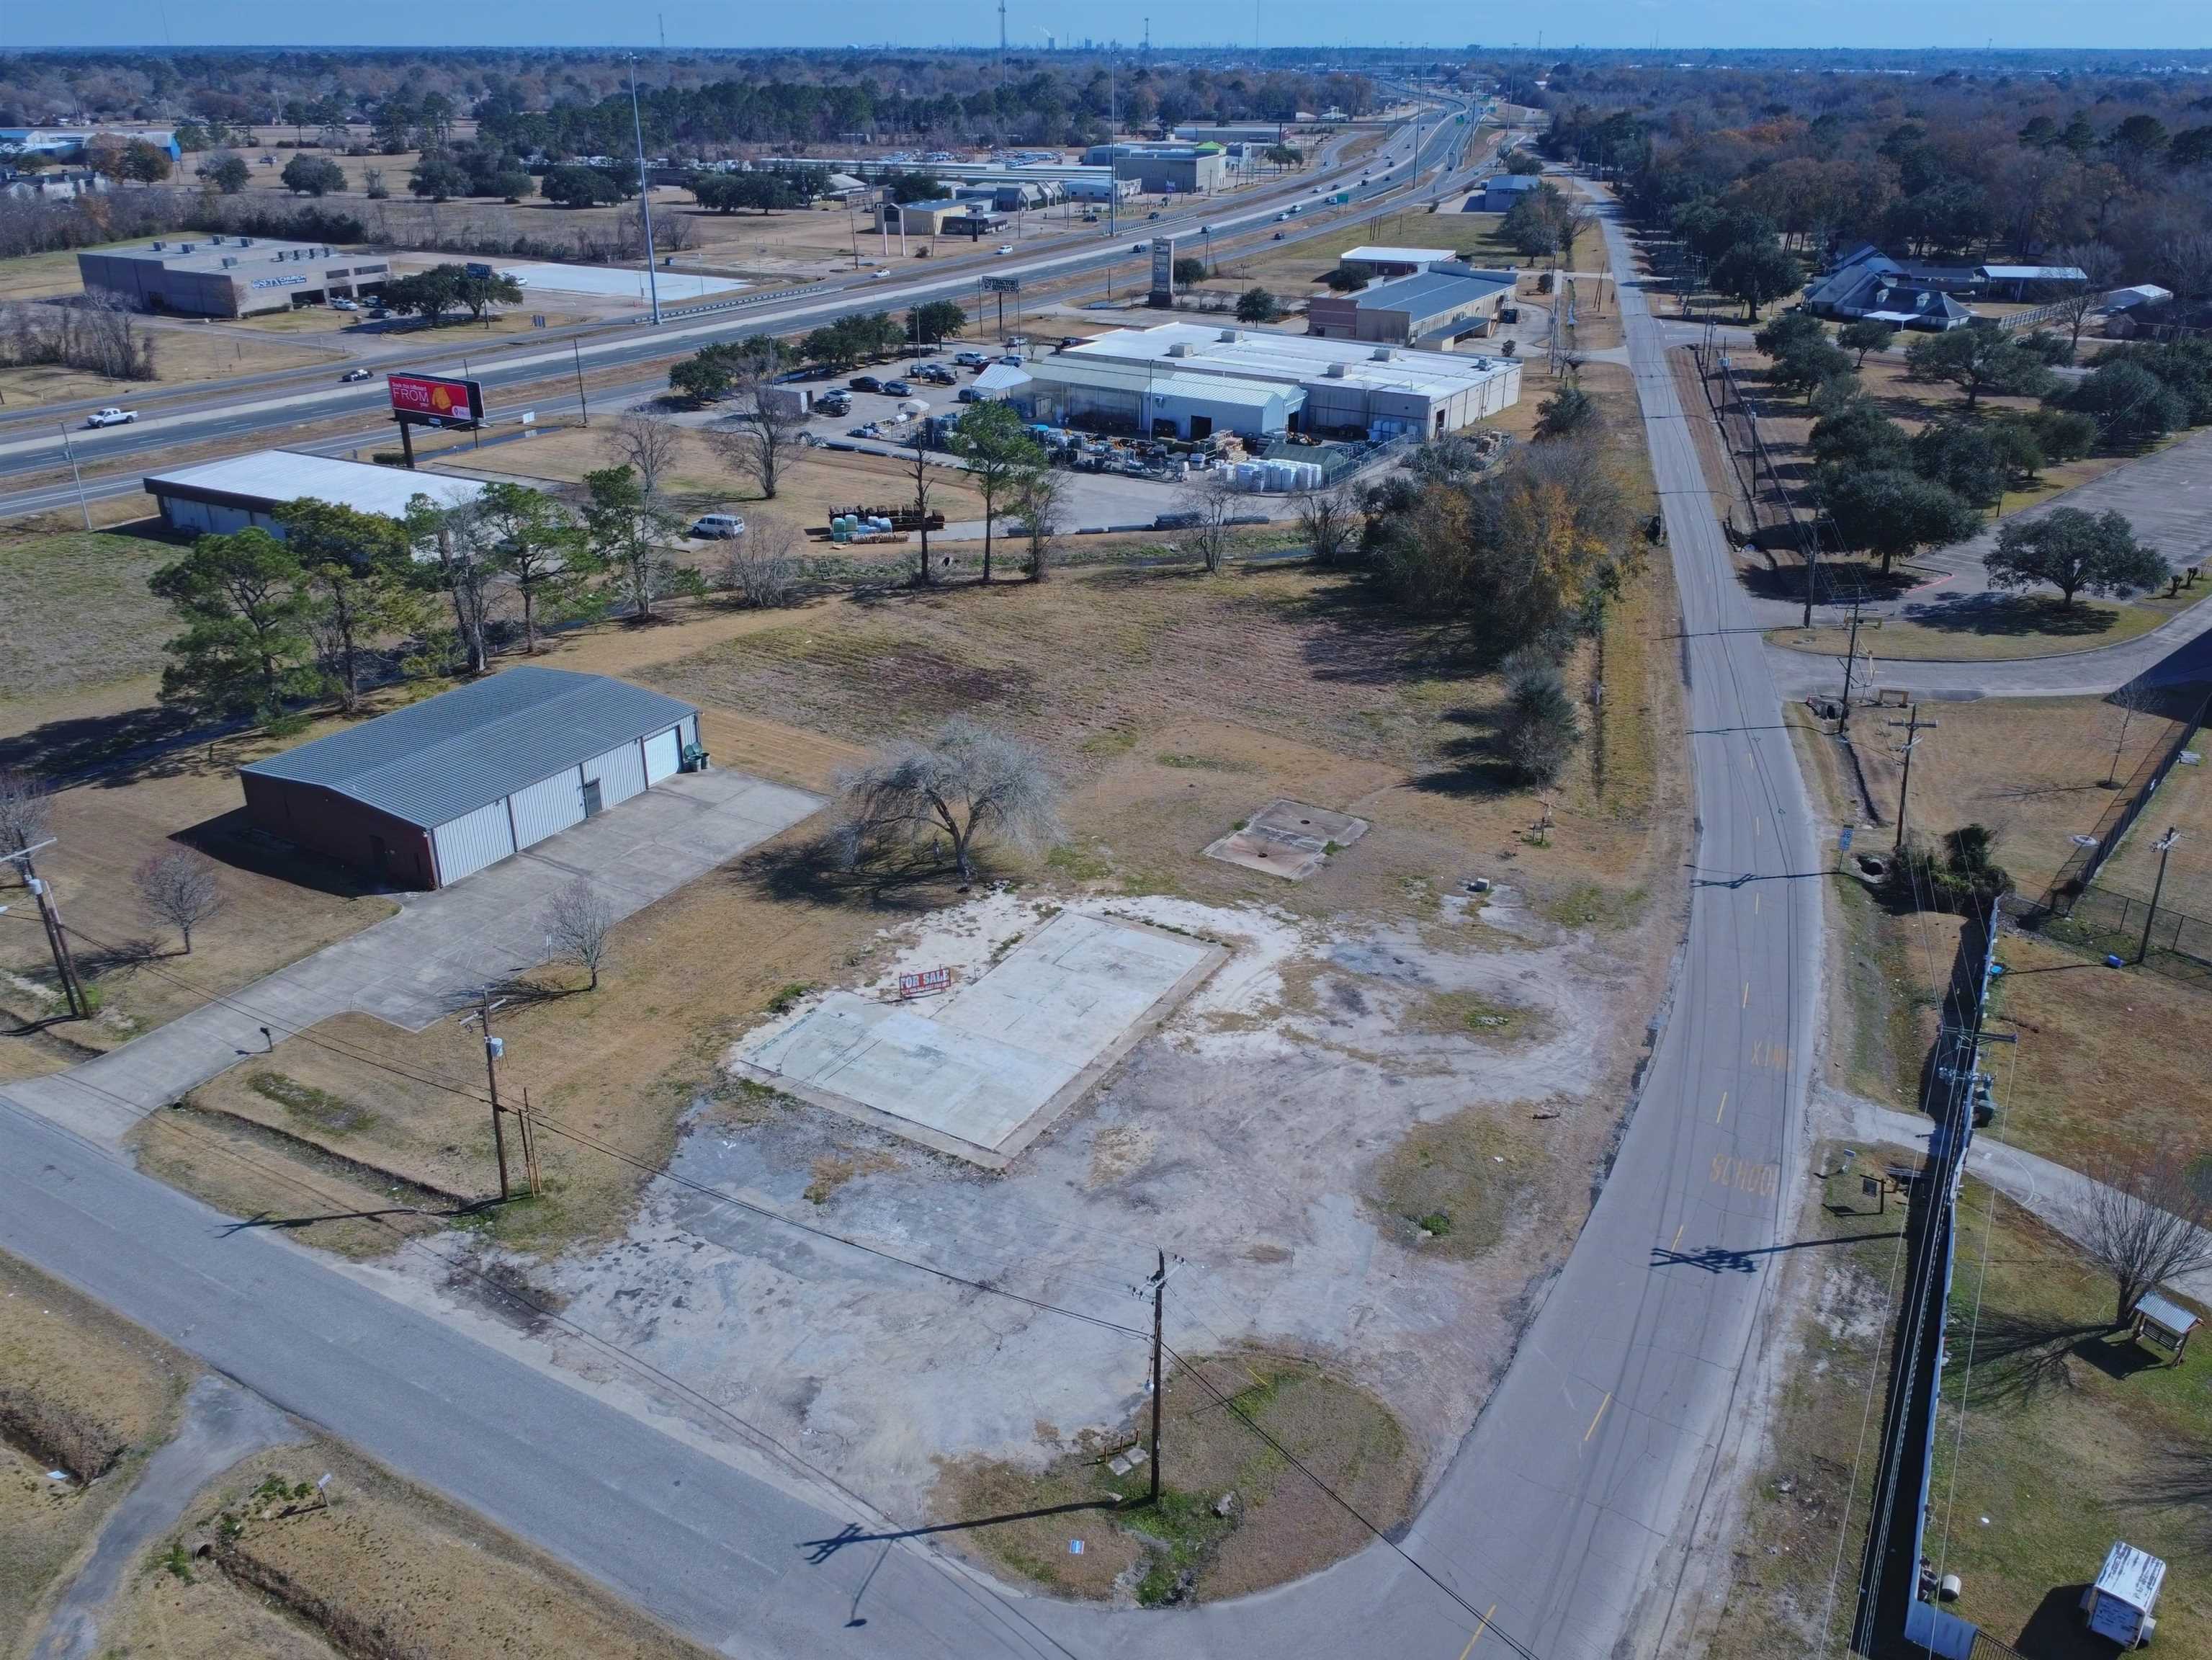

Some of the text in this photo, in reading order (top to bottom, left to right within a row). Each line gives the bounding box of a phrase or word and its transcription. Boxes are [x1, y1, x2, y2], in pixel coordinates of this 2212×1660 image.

[393, 388, 429, 403] FROM
[900, 976, 919, 989] FOR
[923, 969, 949, 984] SALE
[1709, 1153, 1780, 1199] SCHOOL
